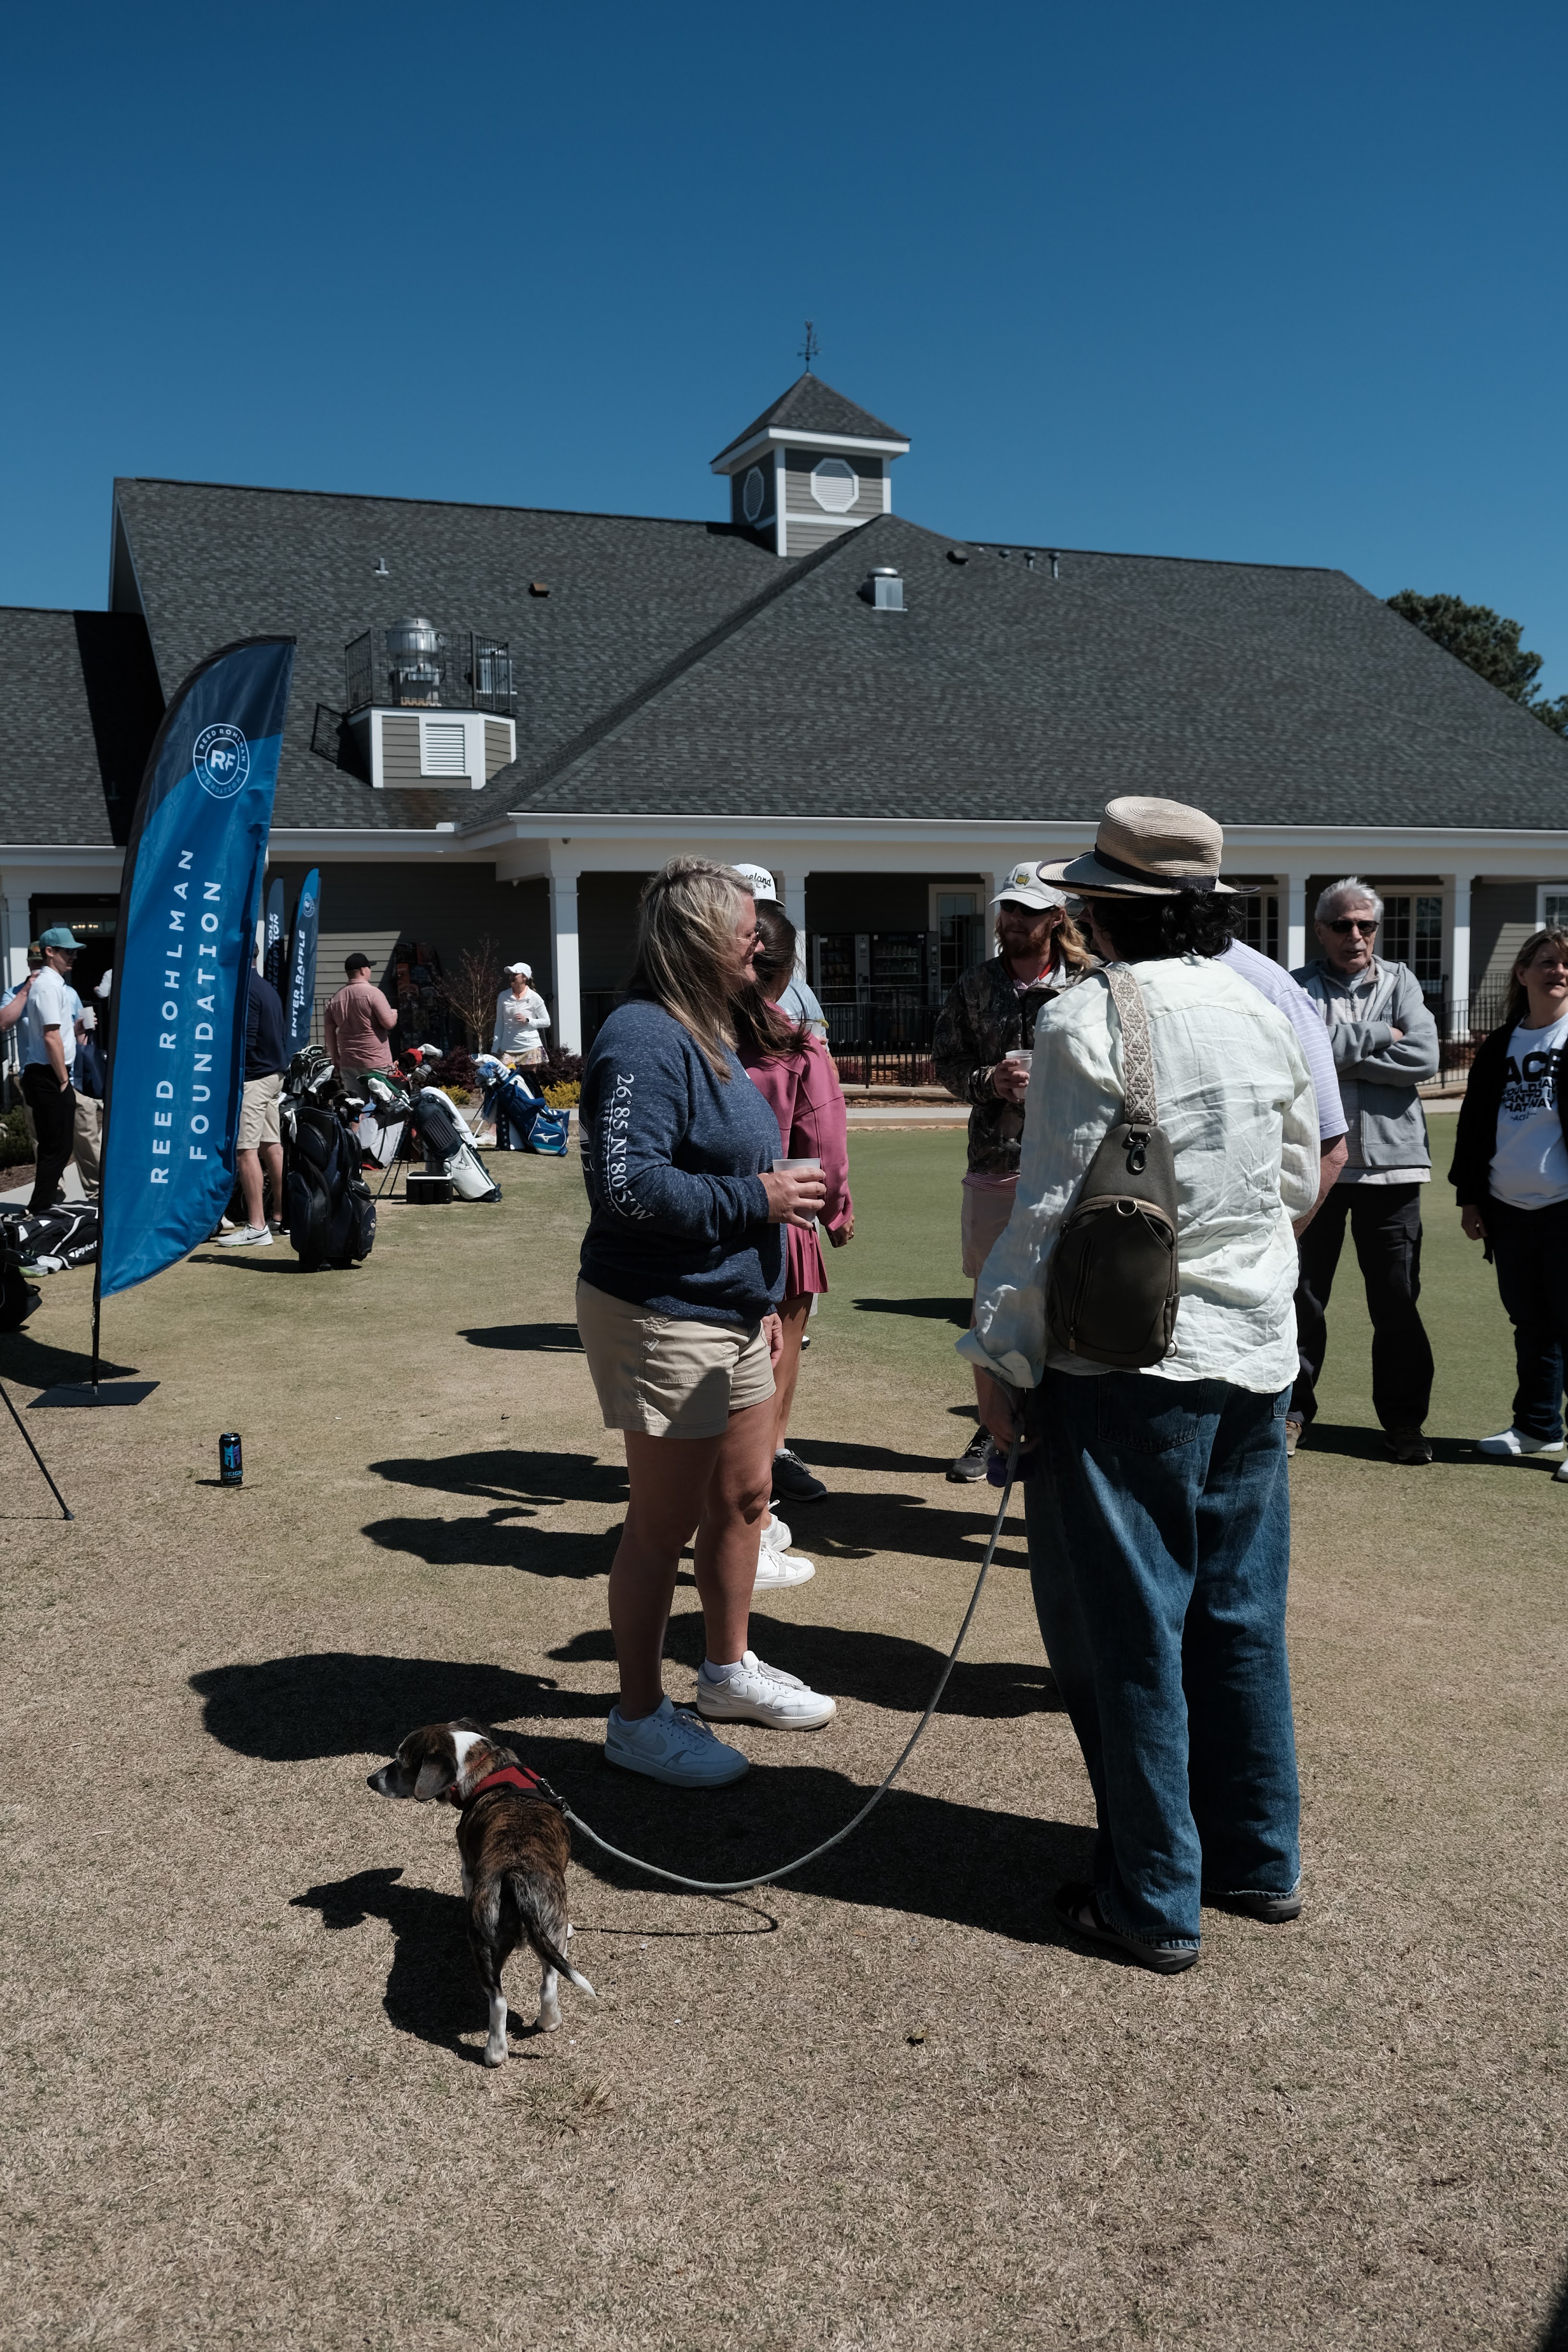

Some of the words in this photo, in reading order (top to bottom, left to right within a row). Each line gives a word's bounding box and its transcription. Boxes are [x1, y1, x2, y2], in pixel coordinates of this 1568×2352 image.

[199, 730, 216, 750] REED
[219, 728, 245, 762] ROHLMAN
[211, 749, 236, 771] RF
[745, 872, 772, 887] eland
[159, 849, 194, 1049] ROHLMAN
[295, 929, 306, 984] RAFFLE
[189, 881, 221, 1160] FOUNDATION
[292, 990, 300, 1037] ENTER
[150, 1080, 174, 1184] REED
[601, 1167, 616, 1212] FLORIDA
